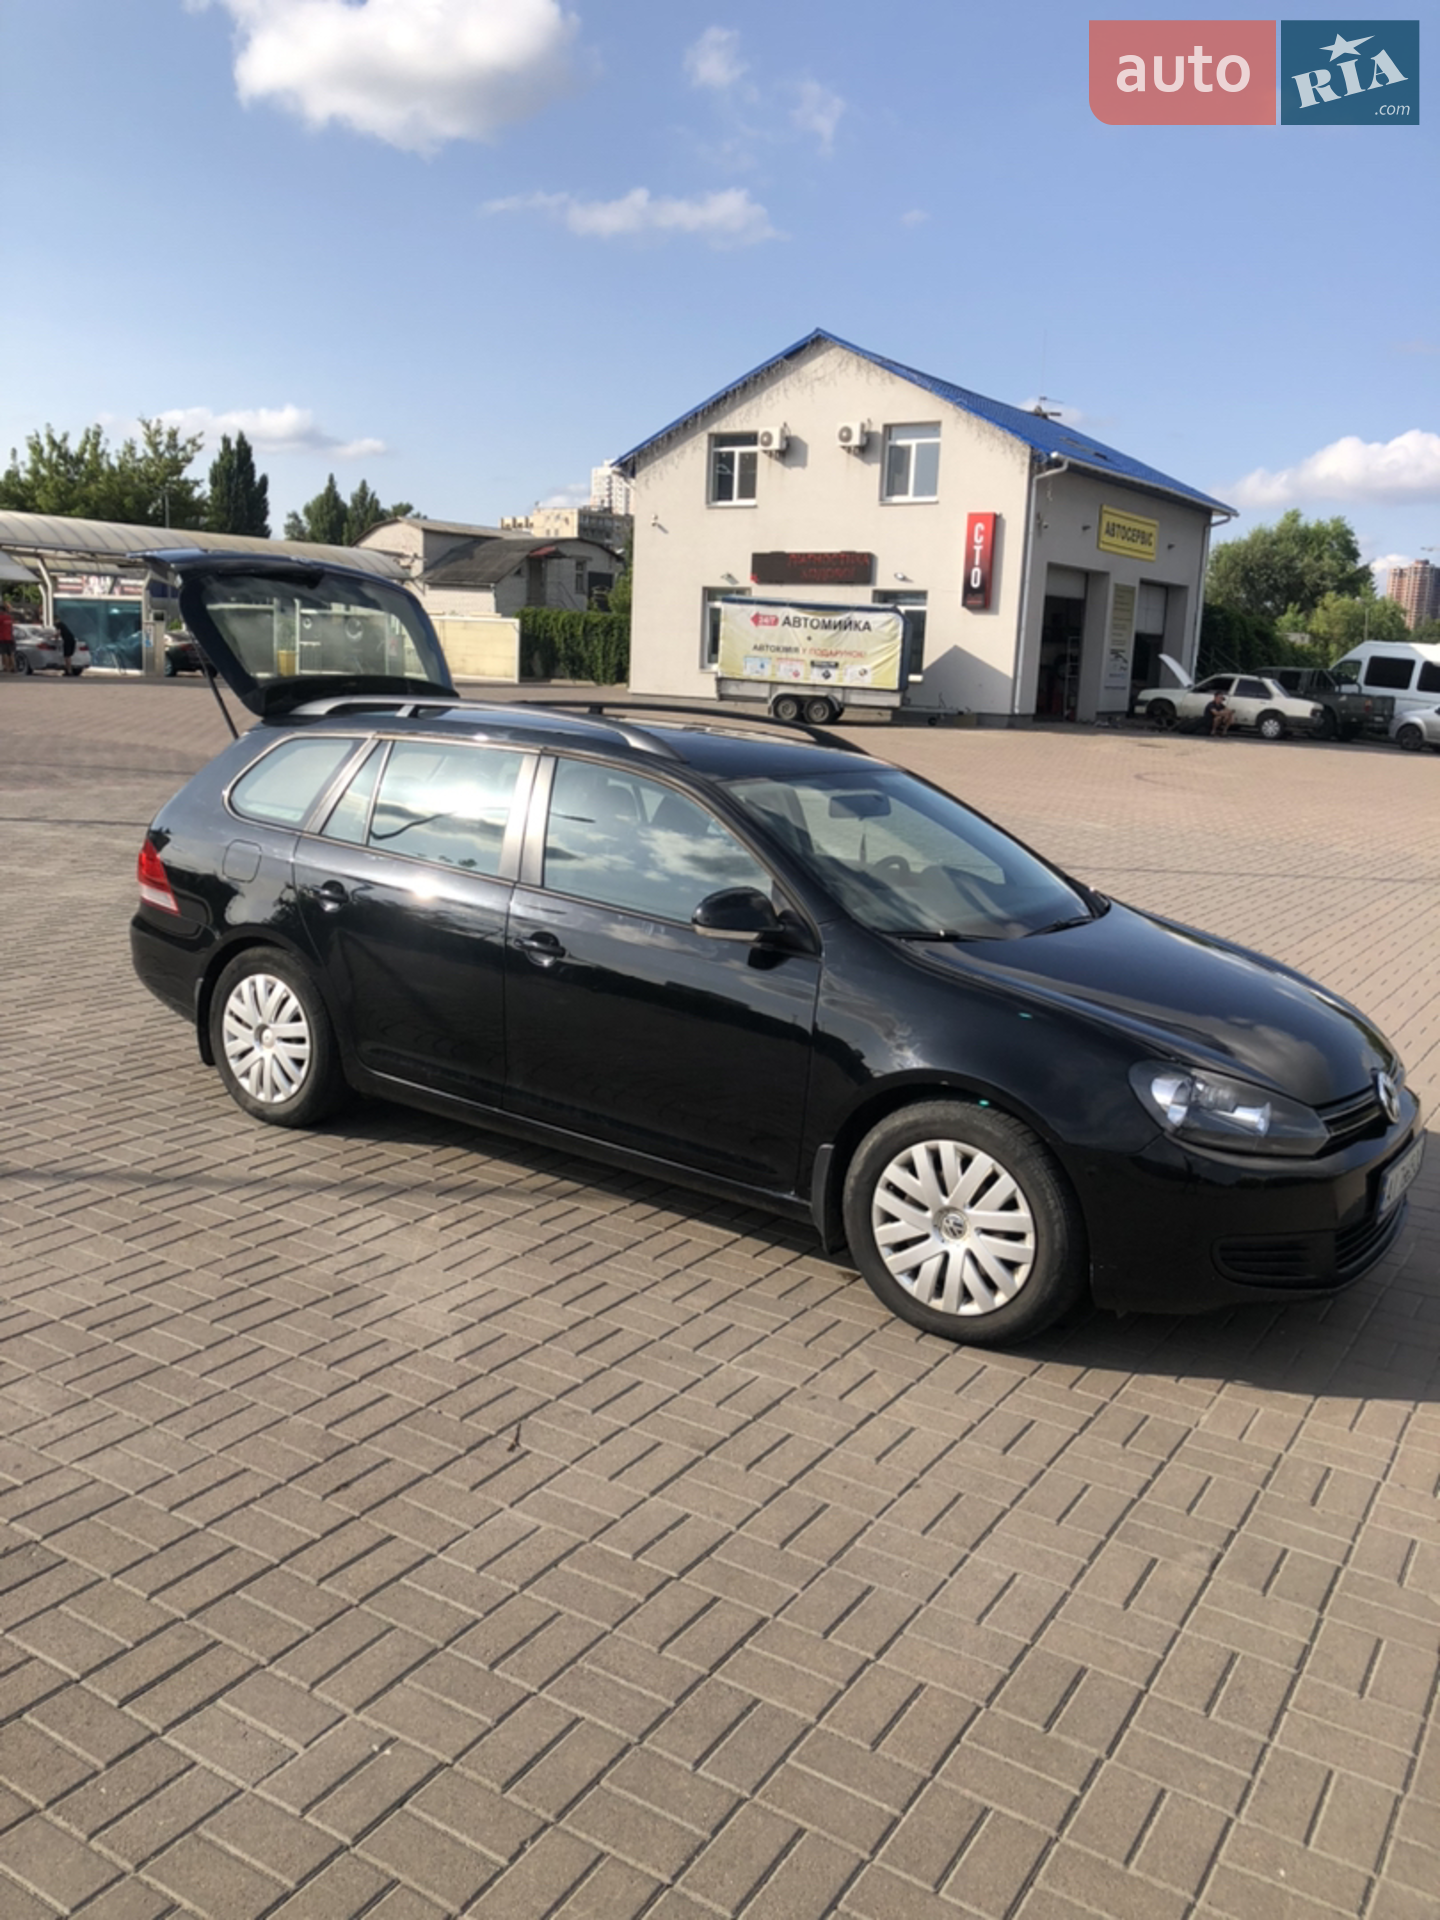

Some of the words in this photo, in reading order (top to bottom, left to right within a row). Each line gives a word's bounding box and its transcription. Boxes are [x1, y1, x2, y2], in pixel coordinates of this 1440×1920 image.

[1105, 520, 1154, 547] АВТОСЕРВІС
[970, 522, 985, 589] СТО
[781, 615, 872, 632] АВТОМИЙКА
